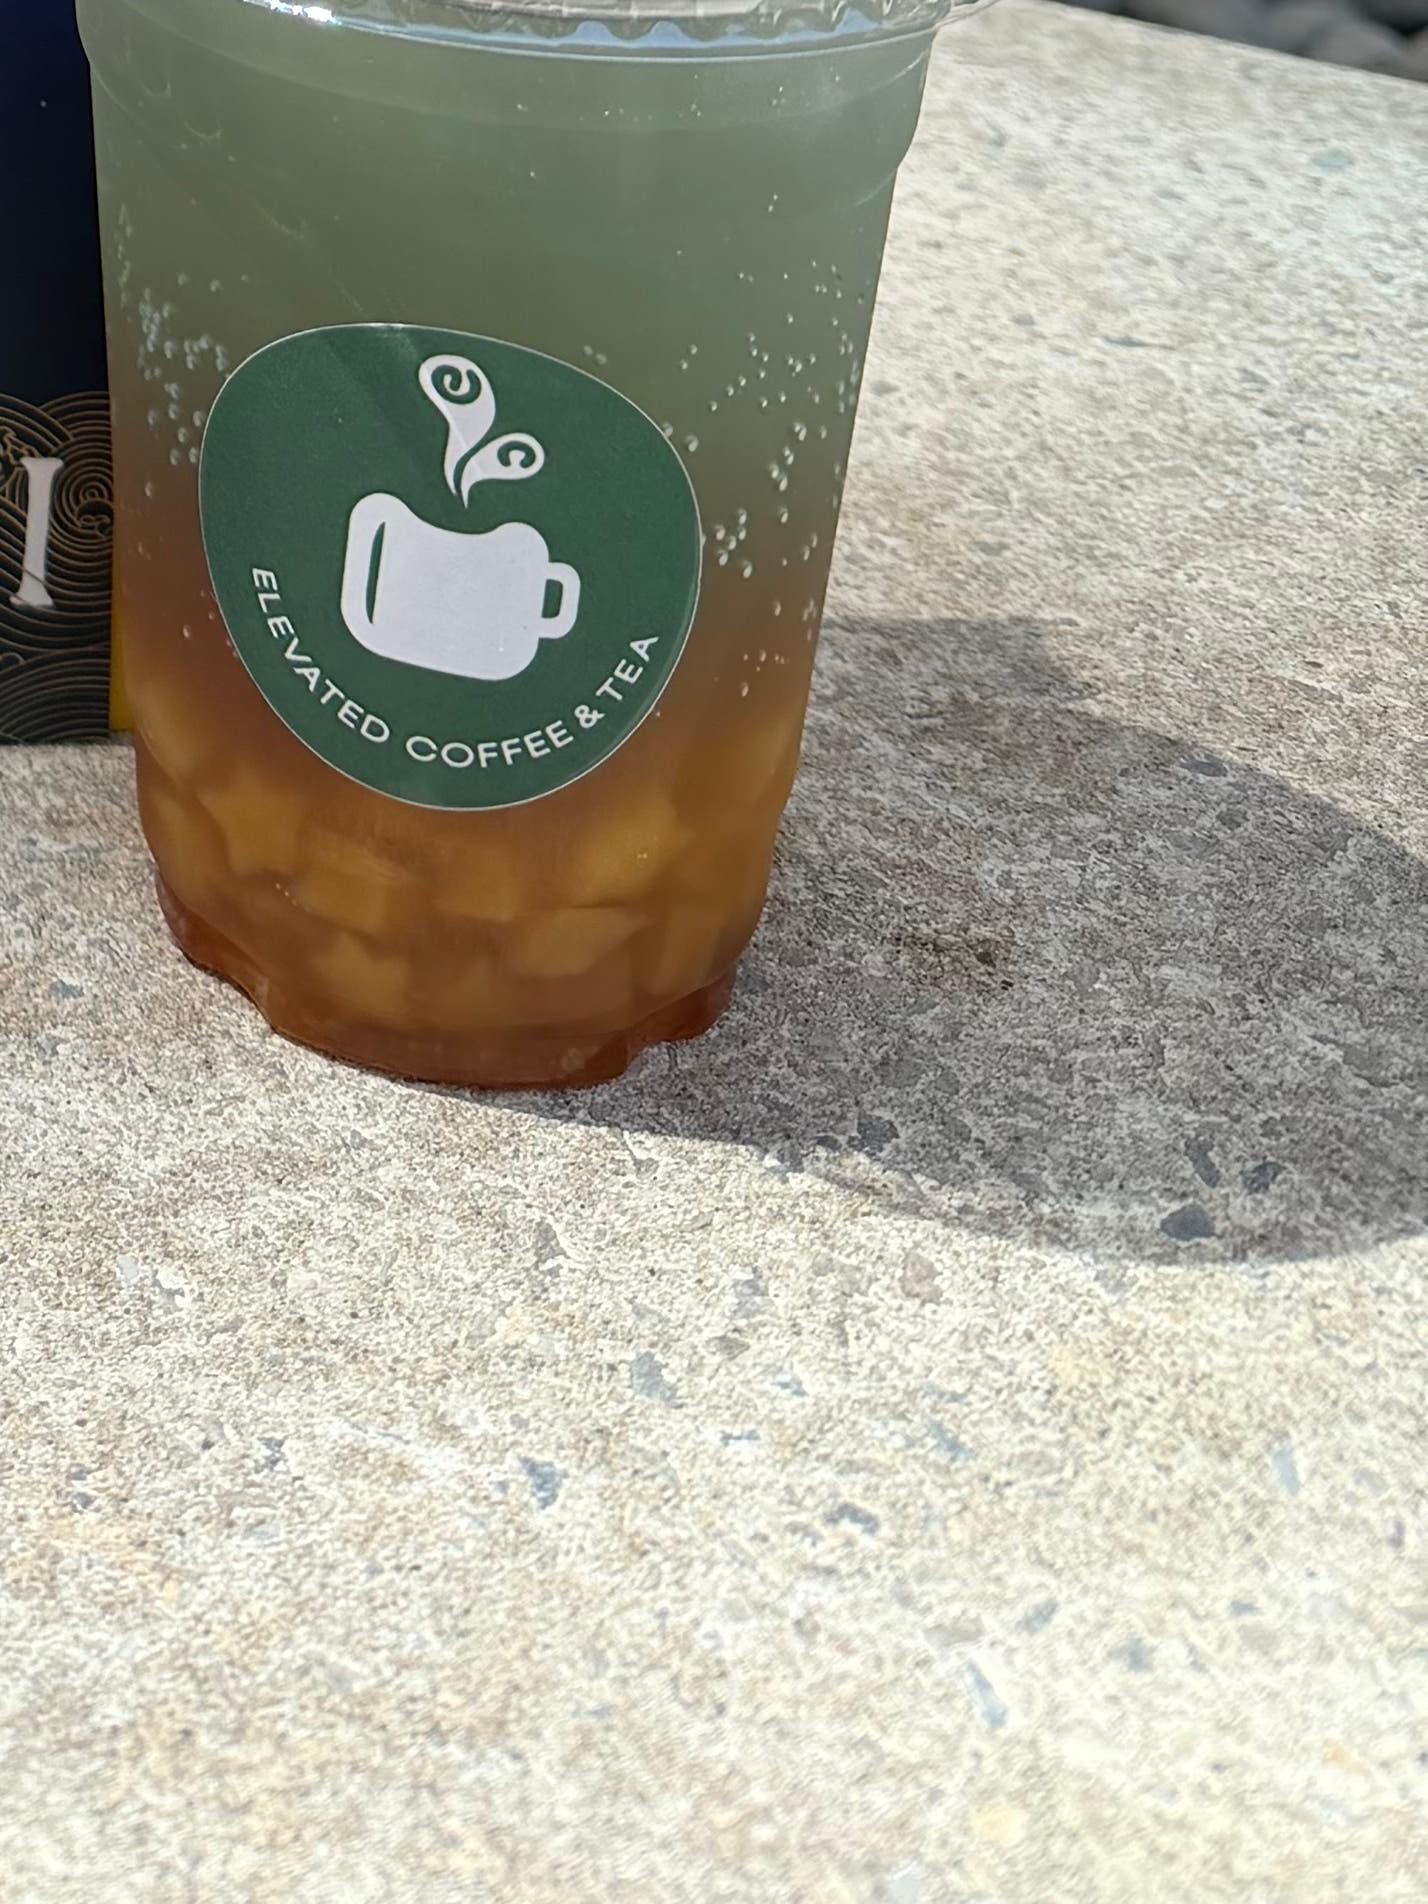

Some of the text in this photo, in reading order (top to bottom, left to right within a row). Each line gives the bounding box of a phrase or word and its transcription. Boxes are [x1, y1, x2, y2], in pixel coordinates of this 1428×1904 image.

[252, 566, 659, 769] ELEVATED COFFEE & TEA
